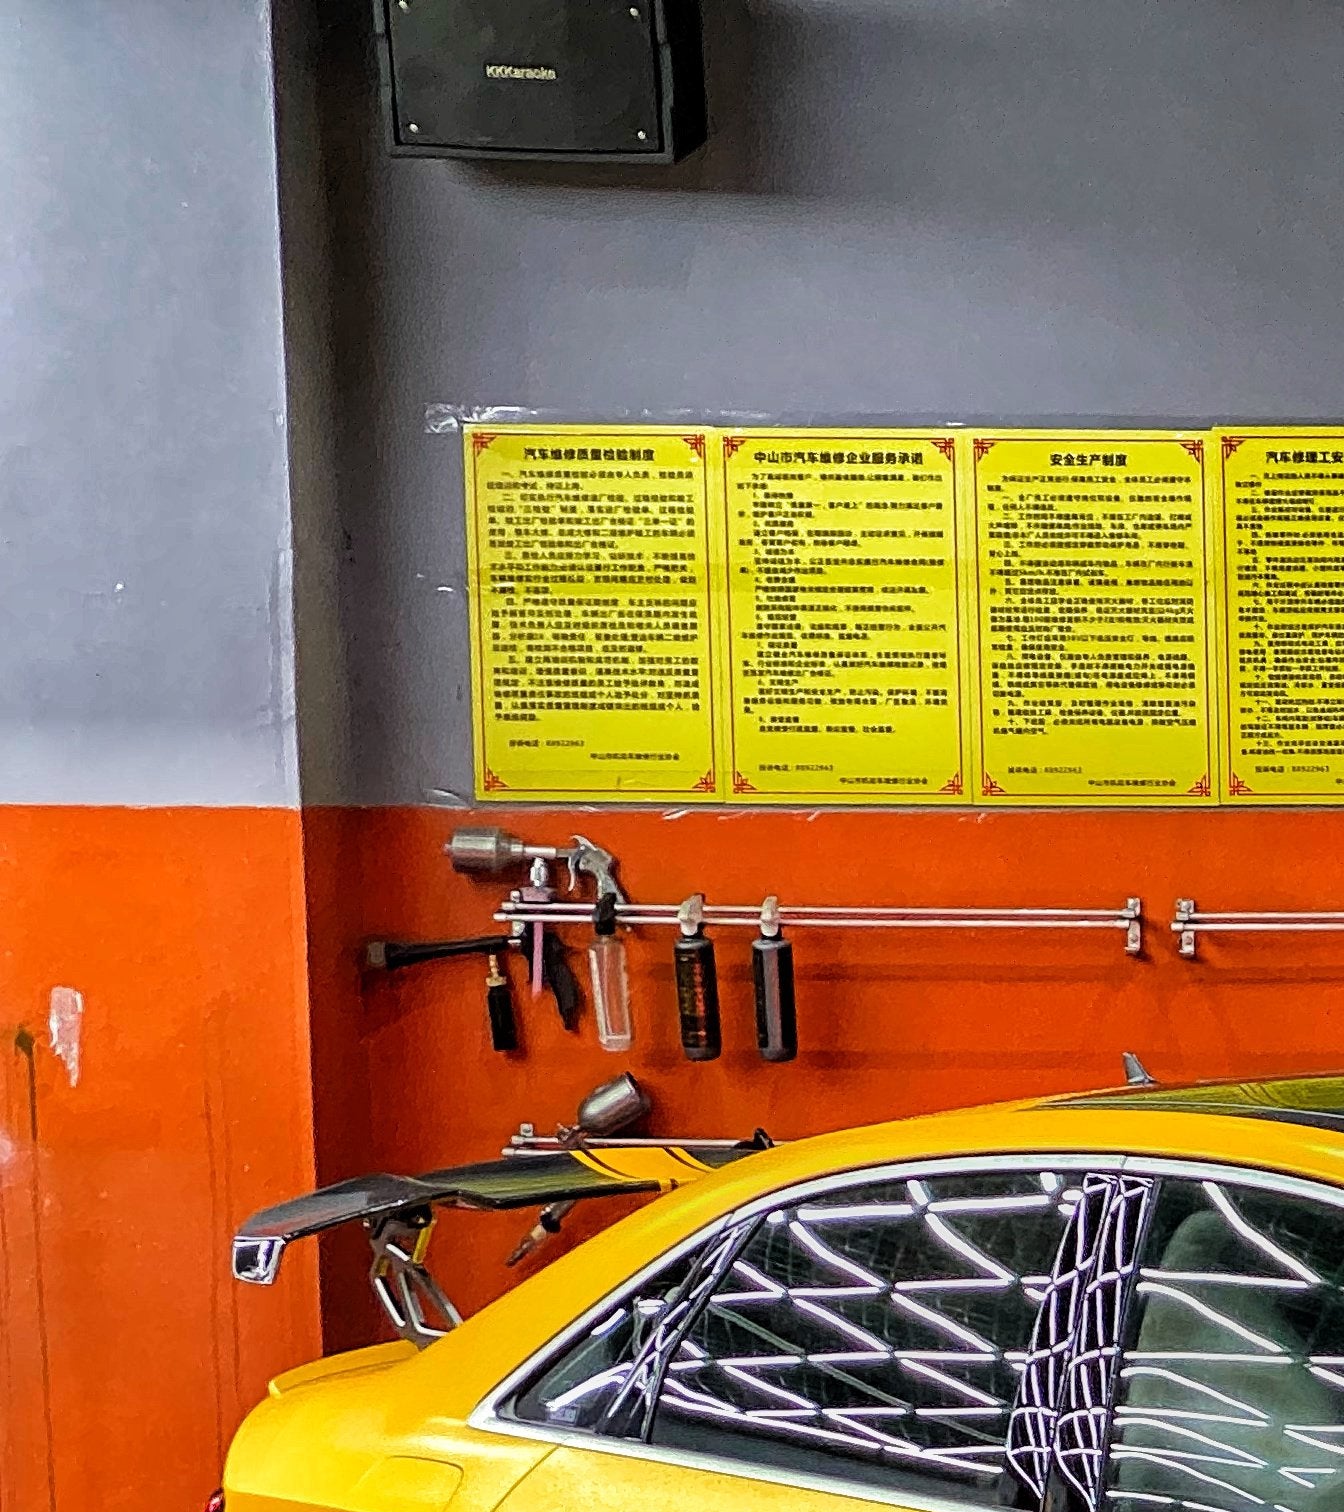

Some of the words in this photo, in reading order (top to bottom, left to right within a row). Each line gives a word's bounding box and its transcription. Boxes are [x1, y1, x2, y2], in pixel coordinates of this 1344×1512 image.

[524, 448, 655, 461] 汽车维修质量检验制度
[754, 451, 924, 465] 中山市汽车维修企业服务承诺
[1050, 454, 1127, 467] 安全生产制度
